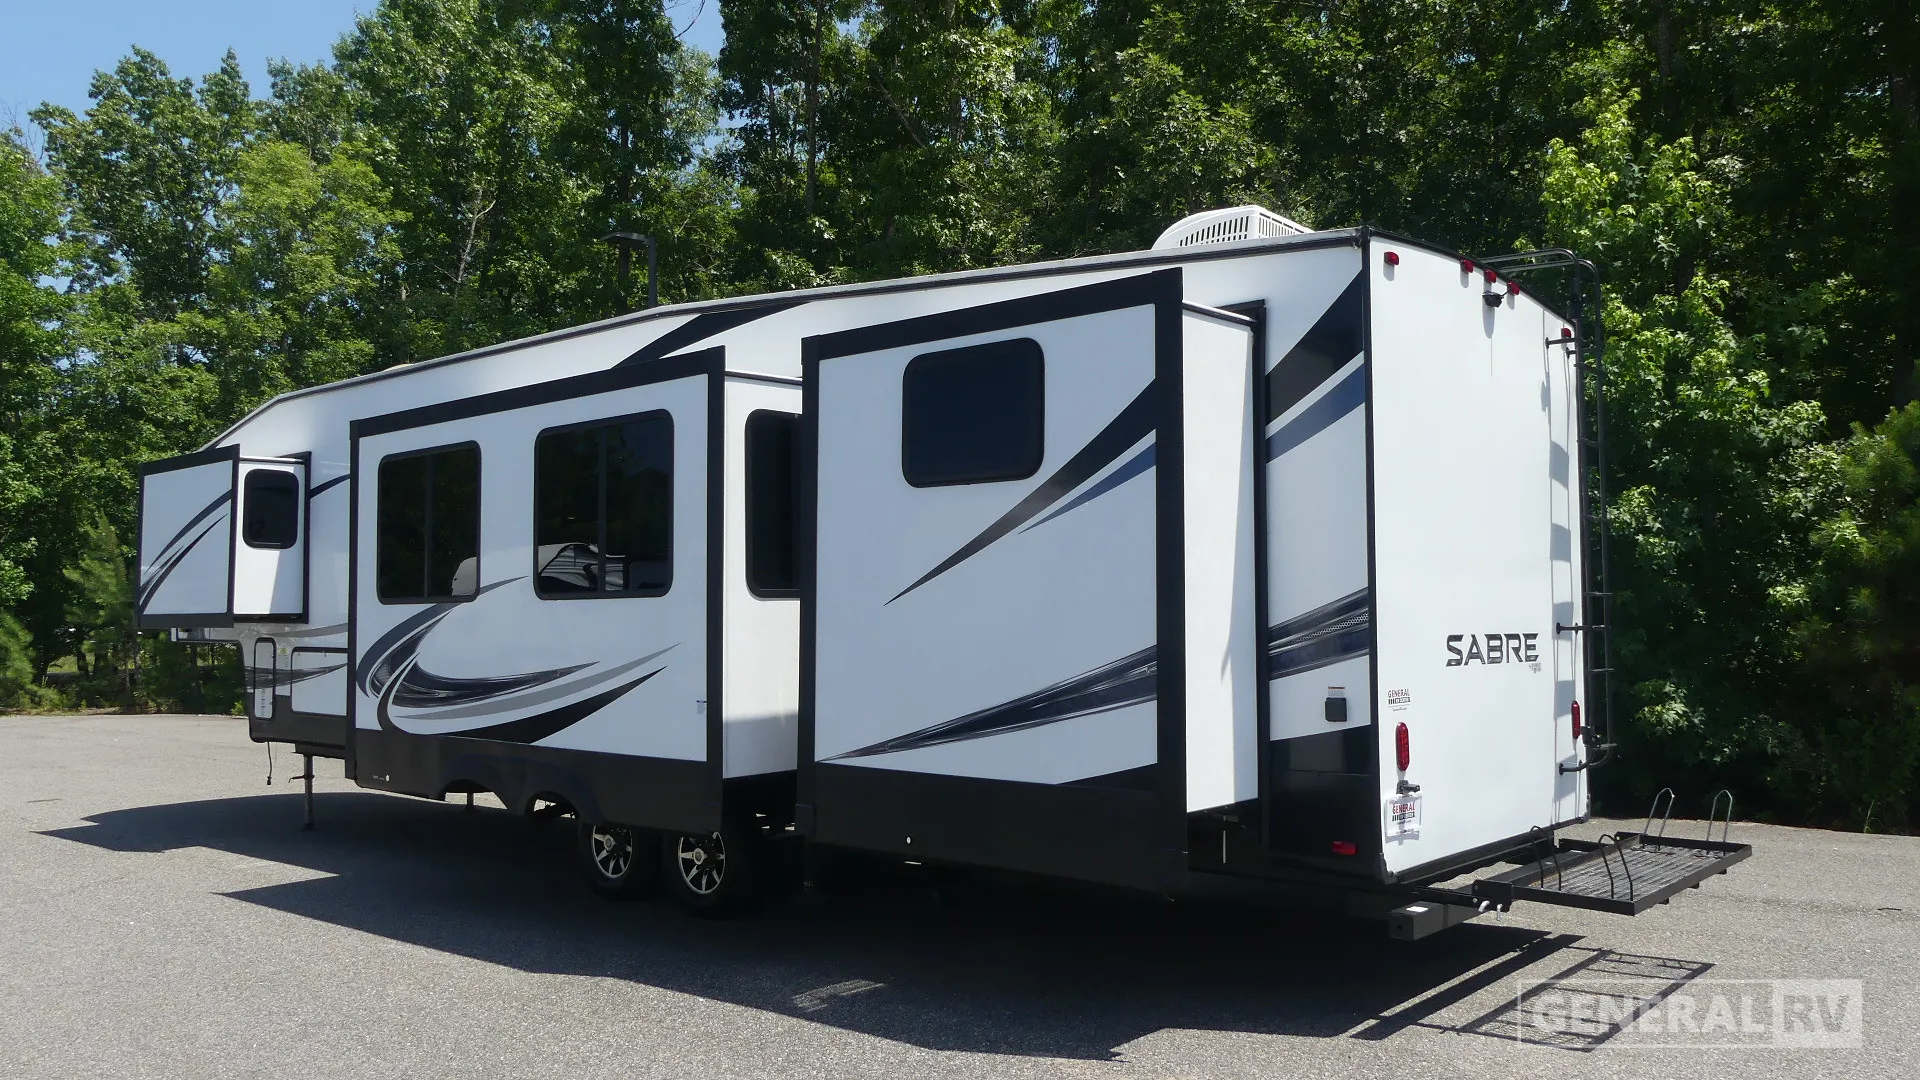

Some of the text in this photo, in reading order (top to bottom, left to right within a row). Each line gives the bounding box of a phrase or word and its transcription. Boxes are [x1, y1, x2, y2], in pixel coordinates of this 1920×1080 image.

[1446, 633, 1539, 666] SABRE
[1387, 688, 1410, 698] GENERAL
[1392, 802, 1415, 814] GENERAL
